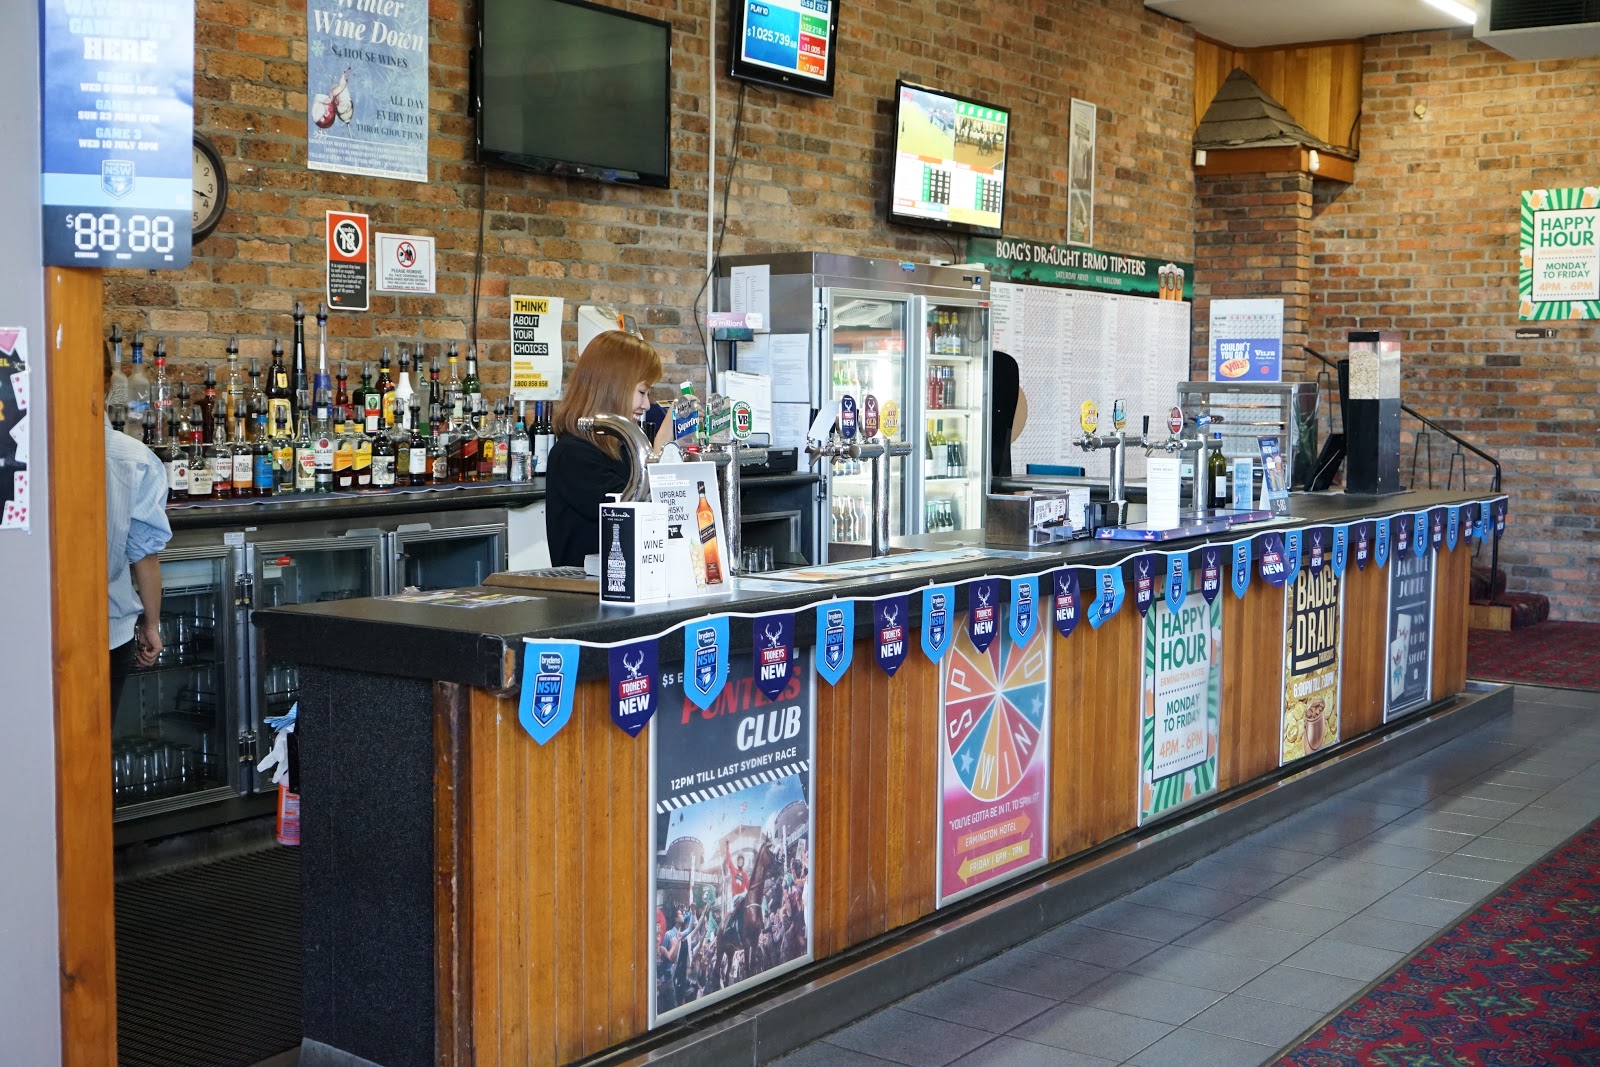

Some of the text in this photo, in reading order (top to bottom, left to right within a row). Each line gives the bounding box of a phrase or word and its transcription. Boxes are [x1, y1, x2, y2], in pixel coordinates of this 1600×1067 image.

[816, 4, 826, 12] 257
[314, 9, 424, 52] Wine Down
[84, 37, 159, 64] HERE
[344, 49, 376, 64] HOUSE
[378, 54, 408, 68] WINES
[390, 95, 424, 110] ALL DAY
[77, 110, 98, 121] SUN
[376, 110, 424, 126] EVERY DAY
[95, 127, 142, 140] GAME 3
[356, 124, 424, 141] THROUGHOUT JUNE
[78, 138, 100, 149] WED
[114, 140, 136, 150] JULY
[104, 165, 132, 176] NSW
[203, 168, 210, 178] 2
[208, 184, 214, 194] 3
[202, 200, 209, 209] 4
[193, 212, 199, 222] 5
[1541, 216, 1596, 231] HAPPY
[1540, 230, 1595, 248] HOUR
[996, 240, 1146, 277] BOAG'S DRAUGHT ERMO TIPSTERS
[1546, 262, 1588, 270] MONDAY
[1055, 270, 1076, 282] SATURDAY
[1103, 277, 1122, 286] WELCOME
[1543, 270, 1591, 279] TO FRIDAY
[1539, 282, 1593, 292] 4PM 6PM
[514, 301, 547, 312] THINK!
[514, 316, 539, 326] ABOUT
[718, 319, 743, 327] million!
[514, 330, 534, 340] YOUR
[514, 344, 548, 354] CHOICES
[1220, 342, 1250, 352] COULDN'T
[1221, 351, 1234, 360] YOU
[1234, 352, 1244, 360] GO
[678, 417, 700, 433] SuperDry
[738, 415, 748, 424] VB
[866, 418, 876, 426] OLD
[659, 490, 687, 499] UPGRADE
[668, 506, 684, 514] HISKY
[644, 540, 664, 550] WINE
[642, 554, 665, 564] MENU
[1358, 552, 1367, 560] NEW
[1311, 558, 1322, 567] NEW
[1262, 564, 1284, 576] NEW
[1204, 580, 1218, 591] NEW
[1296, 564, 1336, 612] BADGE
[1018, 604, 1030, 614] NSW
[1056, 607, 1074, 621] NEW
[931, 616, 944, 626] NSW
[1162, 605, 1206, 638] HAPPY
[883, 628, 900, 640] TOOHEYS
[974, 620, 993, 636] NEW
[1296, 606, 1336, 656] DRAW
[698, 632, 714, 641] brydens
[828, 634, 843, 644] NSW
[764, 649, 785, 660] TOOHEYS
[881, 642, 903, 658] NEW
[1160, 633, 1207, 672] HOUR
[541, 656, 561, 666] brydens
[697, 652, 716, 664] NSW
[760, 664, 787, 681] NEW
[662, 674, 674, 687] $5
[1160, 673, 1190, 687] ERMINGTON
[537, 682, 560, 694] NSW
[622, 679, 648, 694] TOOHEYS
[681, 667, 802, 724] PUNTS
[620, 694, 650, 716] NEW
[1166, 693, 1200, 716] MONDAY
[1164, 709, 1200, 733] TO FRIDAY
[736, 705, 801, 750] CLUB
[1159, 730, 1203, 758] 4PM 6PM
[671, 747, 797, 790] 12PM TILL LAST SYDNEY RACE
[972, 808, 990, 824] GOTTA
[990, 806, 998, 817] BE
[998, 804, 1004, 814] IN
[1012, 800, 1018, 810] TO
[965, 822, 1016, 847] ERMINGTON HOTEL
[969, 846, 1023, 873] FRIDAY 6PM 7PM
